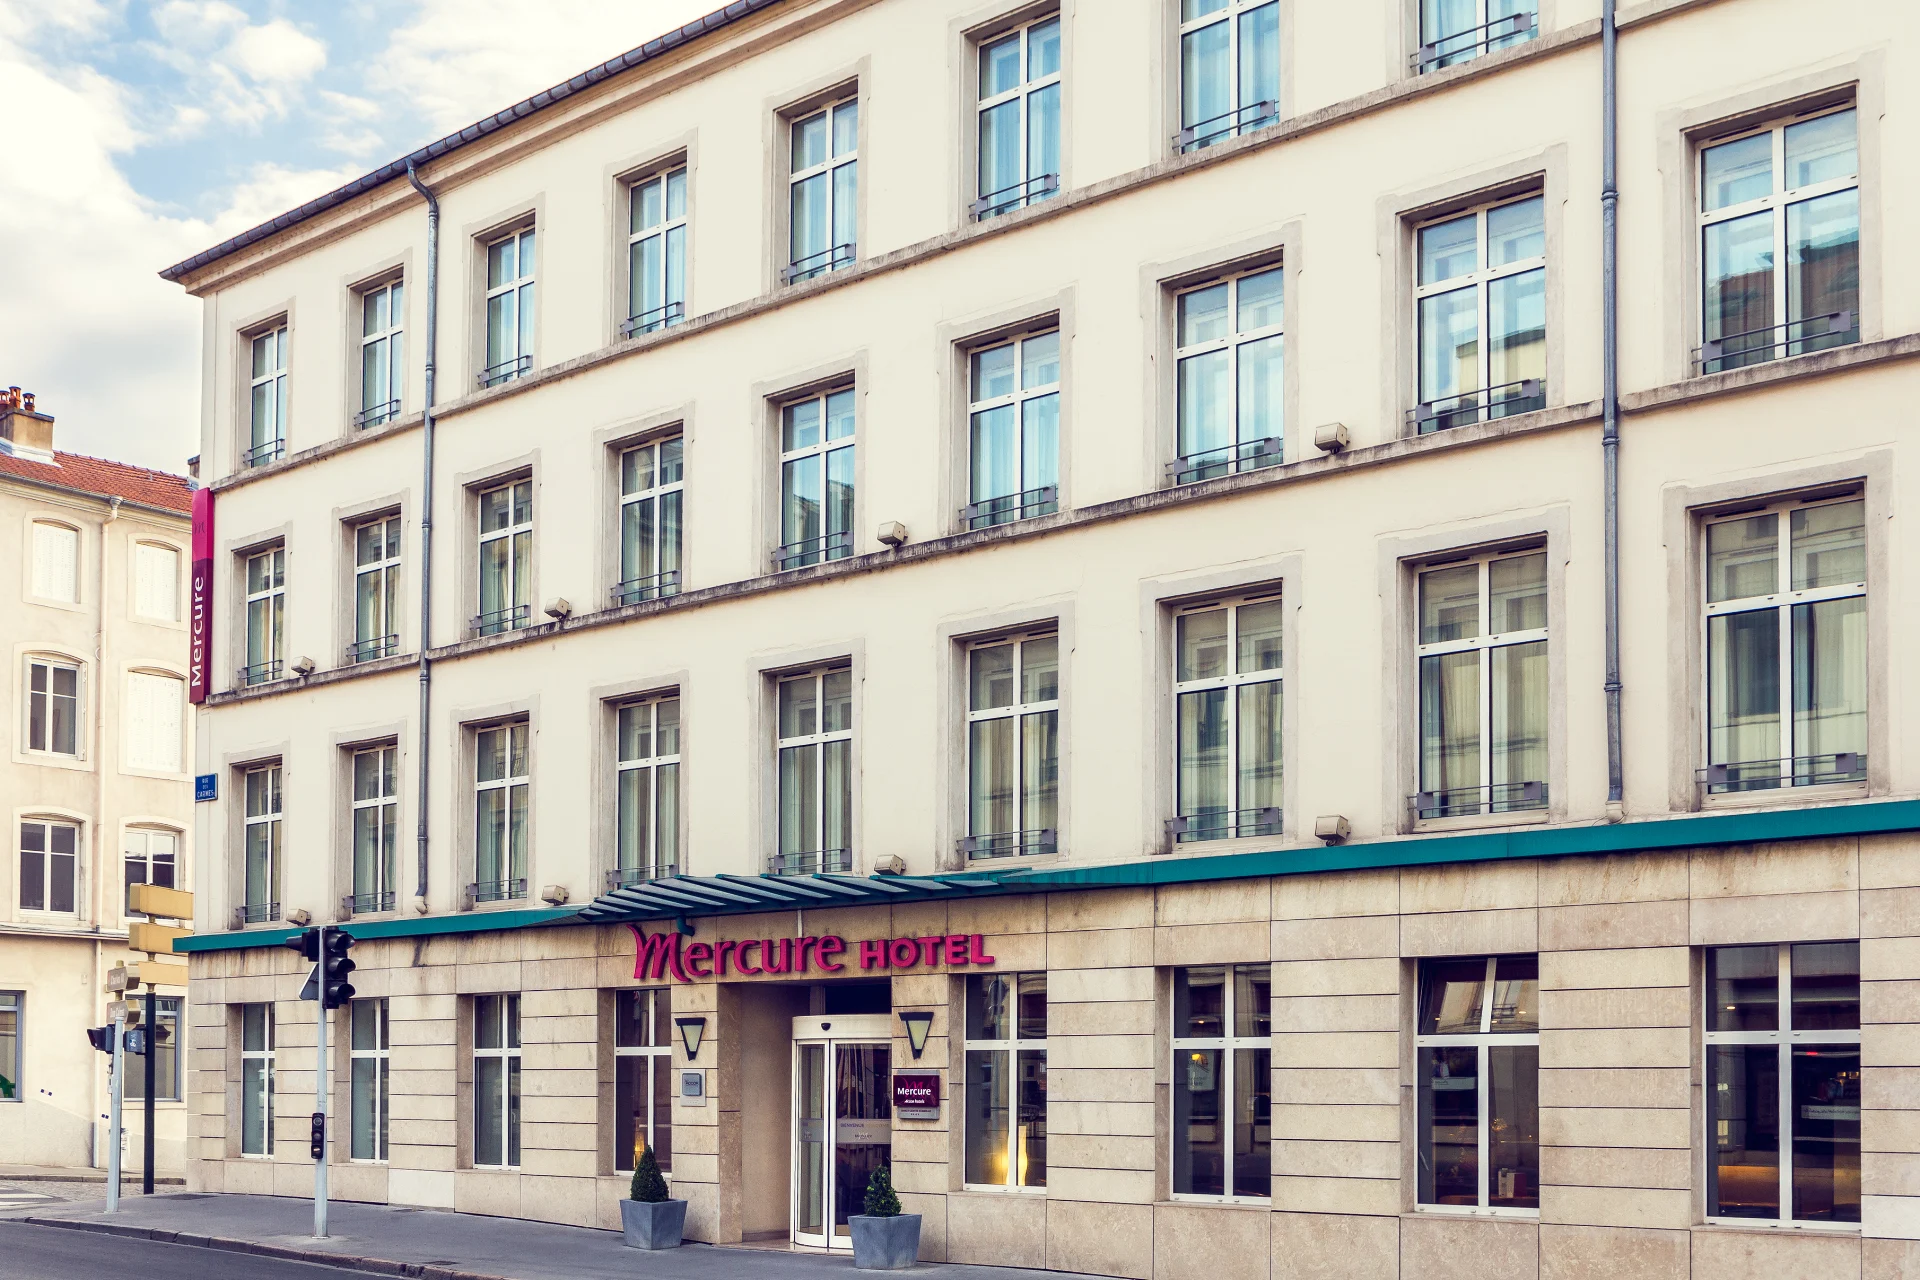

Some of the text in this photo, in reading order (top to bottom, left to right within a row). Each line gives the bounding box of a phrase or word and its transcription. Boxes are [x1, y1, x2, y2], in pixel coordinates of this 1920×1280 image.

[191, 576, 204, 687] Mercure
[626, 923, 995, 982] Mercure HOTEL
[897, 1087, 932, 1096] Mercure
